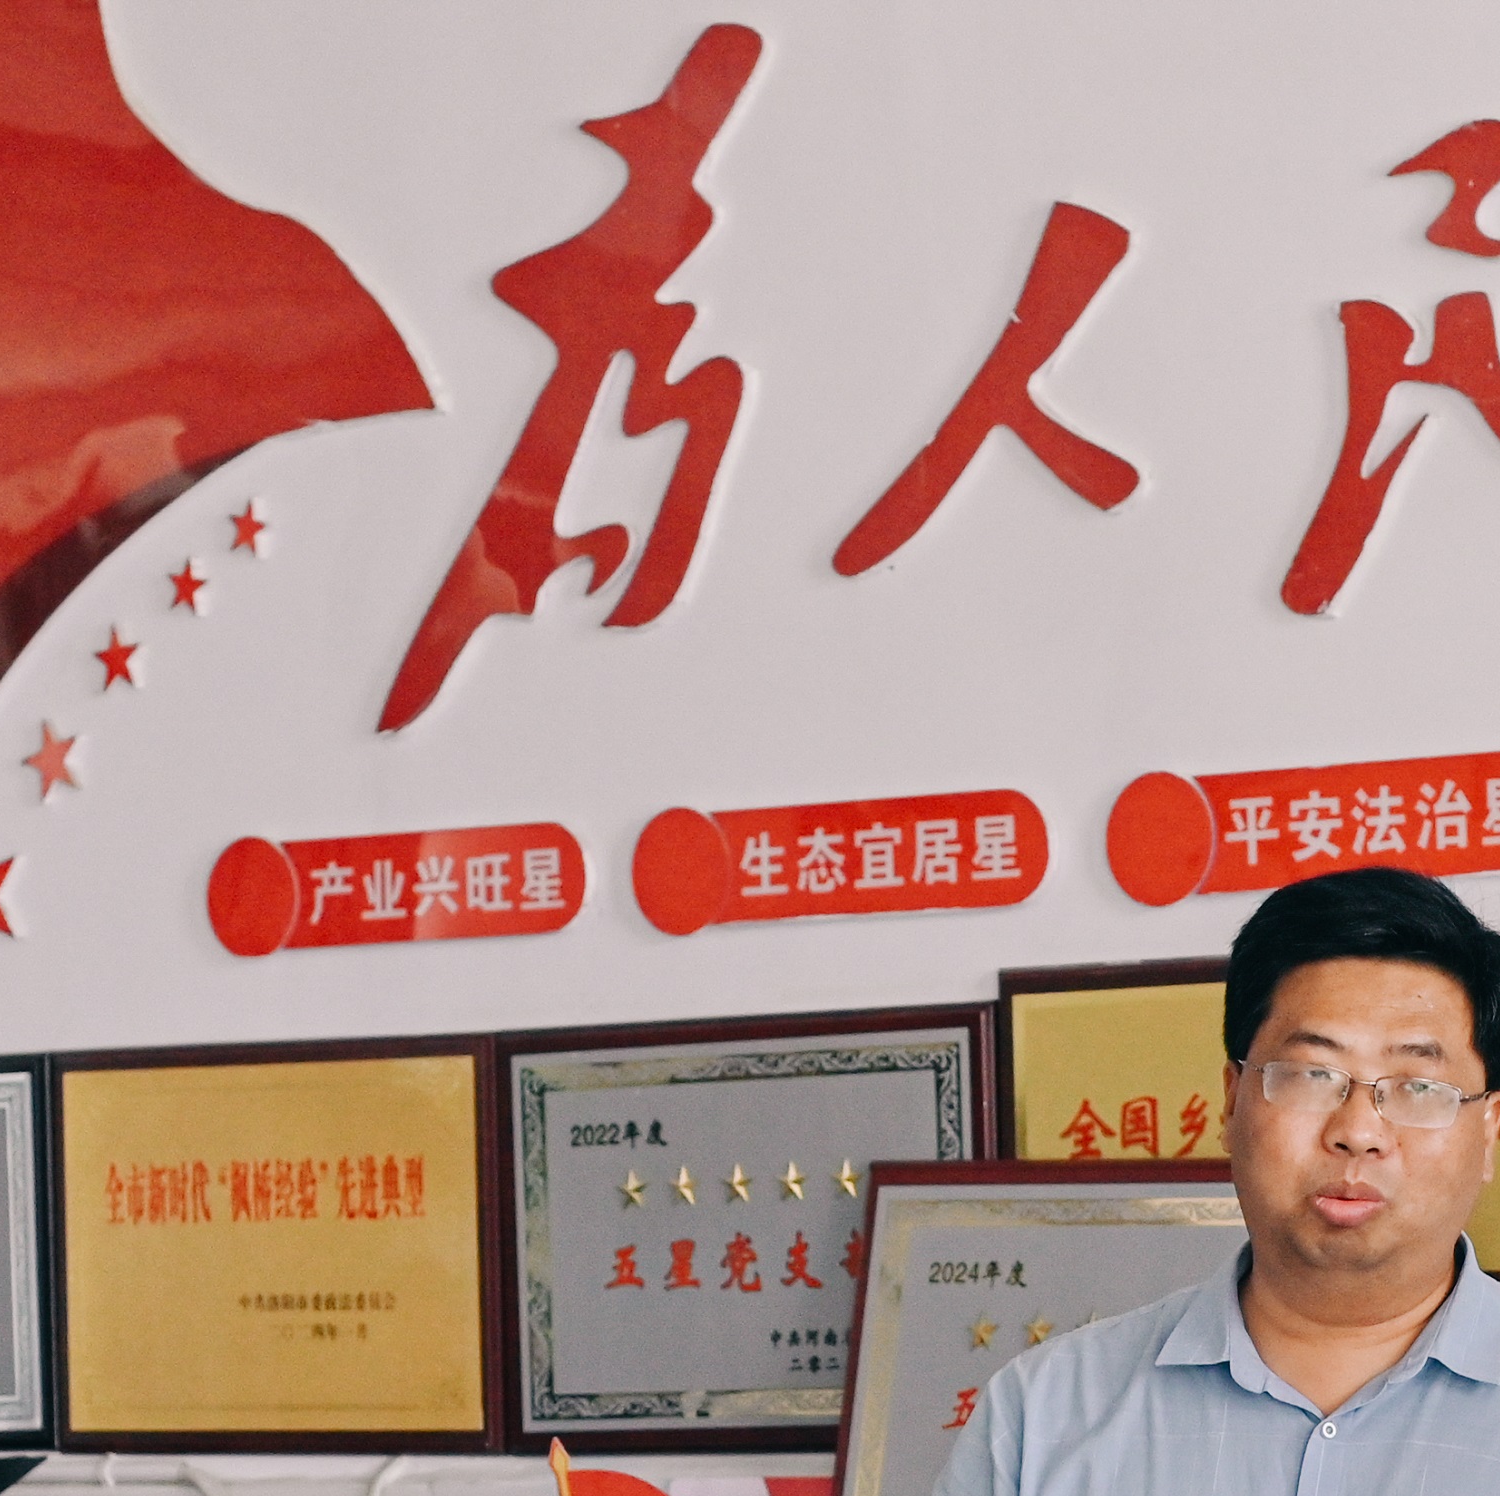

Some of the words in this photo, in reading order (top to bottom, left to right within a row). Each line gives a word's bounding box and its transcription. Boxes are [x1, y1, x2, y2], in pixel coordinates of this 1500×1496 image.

[309, 850, 566, 925] 产业兴旺星
[738, 814, 1024, 899] 生态宜居星
[570, 1120, 667, 1149] 2022年度
[1059, 1093, 1227, 1160] 全国乡
[928, 1259, 1027, 1289] 2024年度
